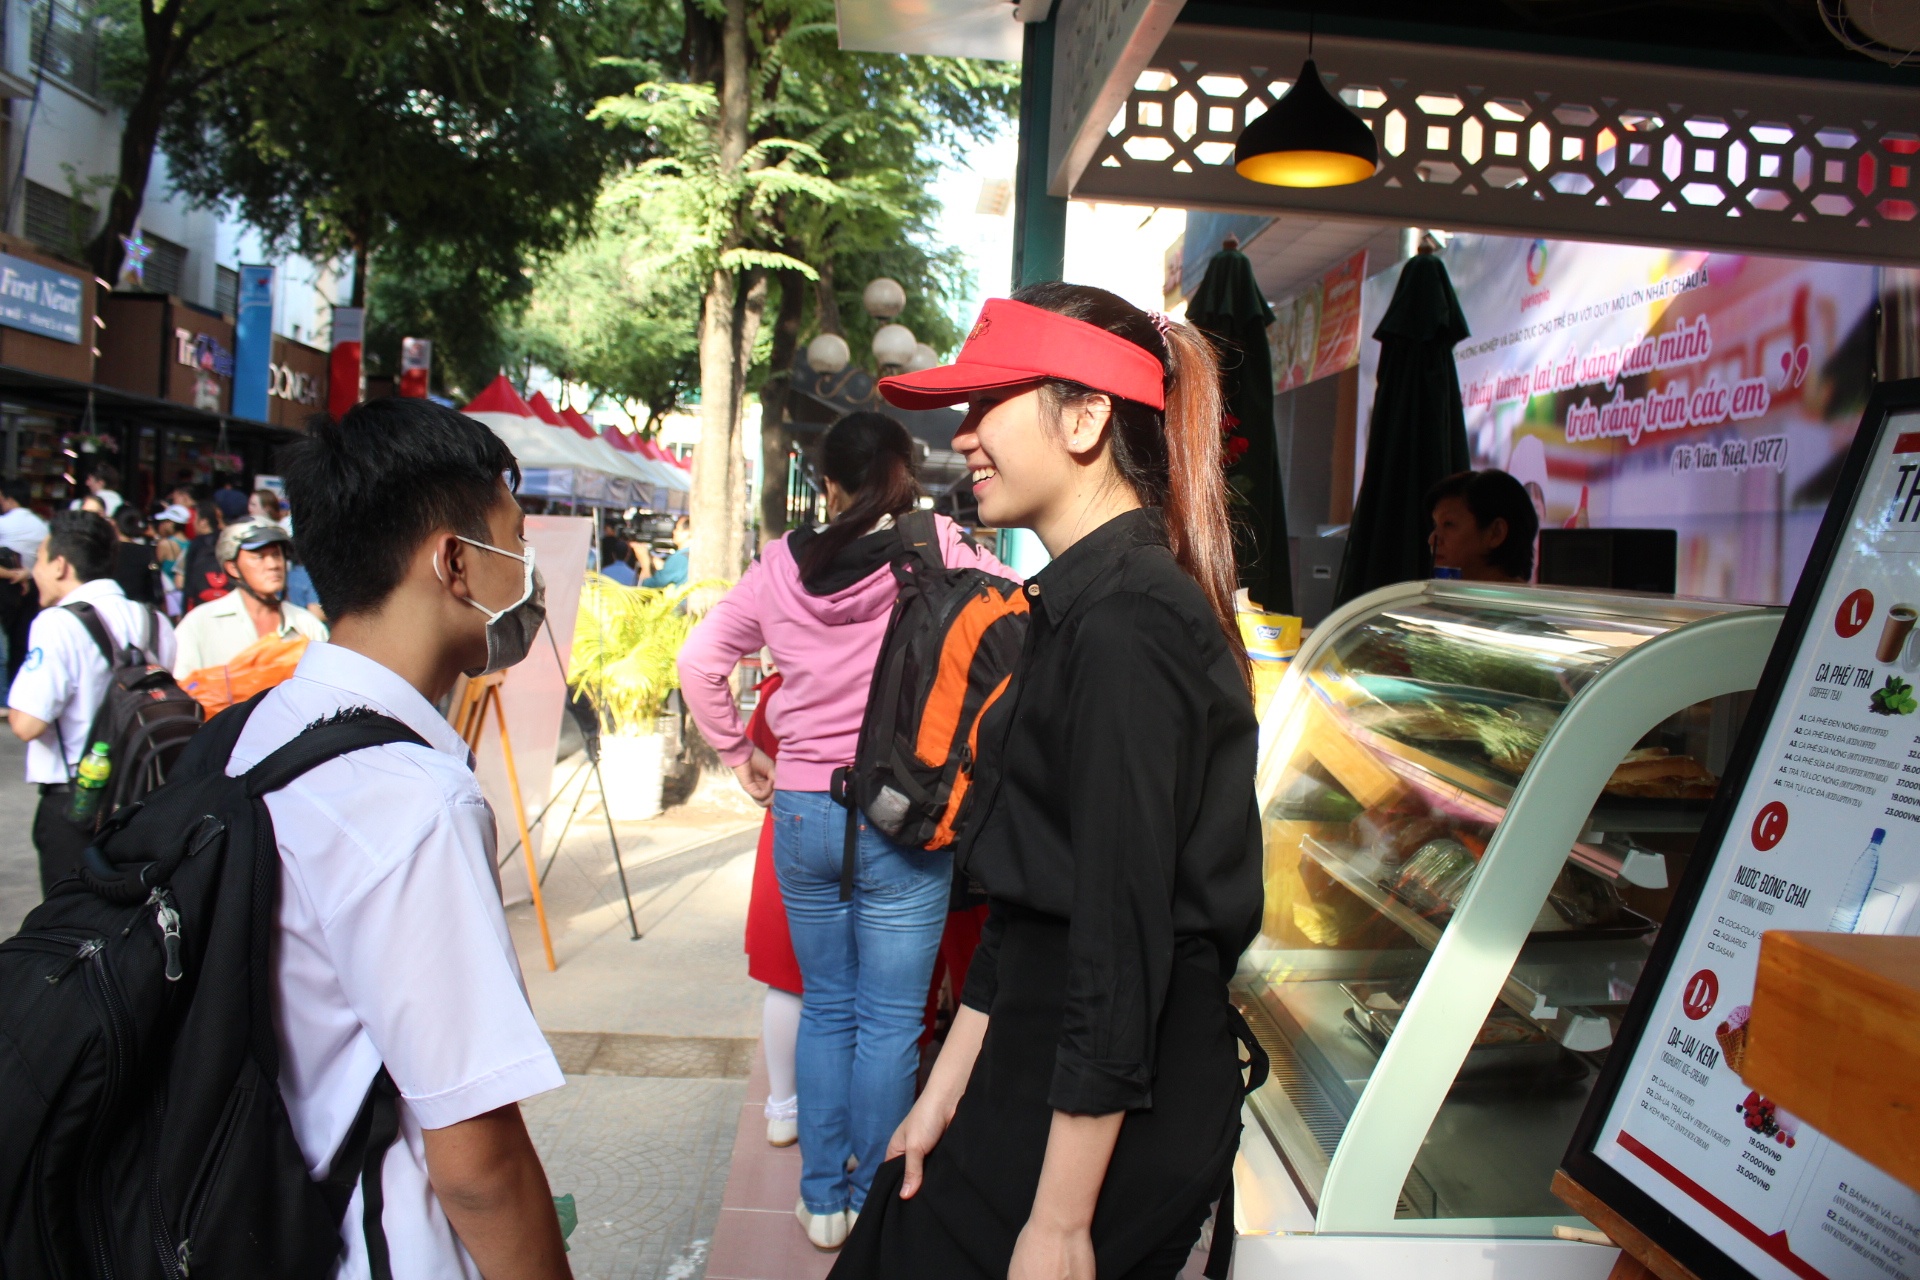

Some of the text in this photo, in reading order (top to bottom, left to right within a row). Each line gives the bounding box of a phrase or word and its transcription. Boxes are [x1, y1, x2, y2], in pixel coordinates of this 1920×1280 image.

[1533, 361, 1553, 391] lai
[1580, 343, 1618, 387] sáng
[1621, 332, 1654, 372] của
[1657, 320, 1709, 364] mình
[1567, 397, 1600, 438] trên
[1646, 388, 1686, 426] trán
[1691, 379, 1729, 420] các
[1731, 382, 1766, 413] em
[1751, 438, 1789, 468] 1977)
[1785, 883, 1812, 909] CHAI
[1696, 1043, 1720, 1070] KEM
[1749, 1136, 1782, 1162] 19.000VNĐ
[1741, 1150, 1776, 1177] 27.000VNĐ
[1736, 1164, 1771, 1191] 35.000VNĐ
